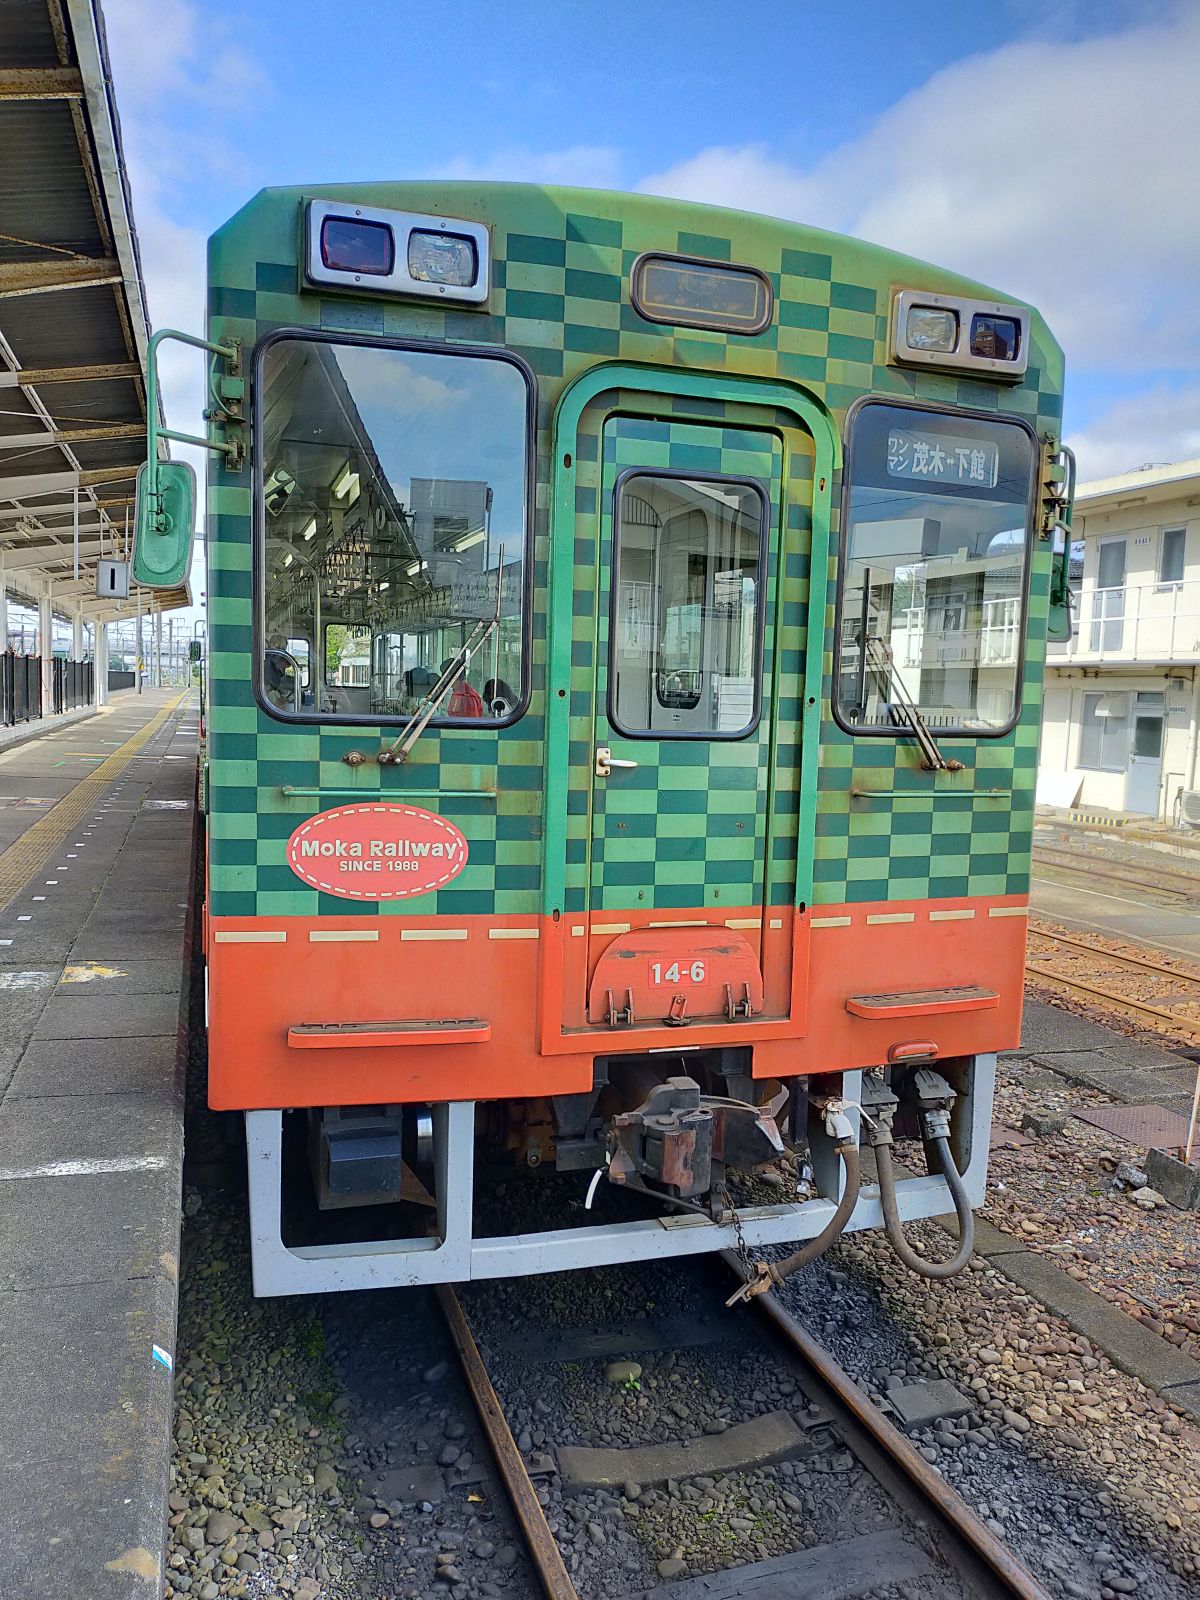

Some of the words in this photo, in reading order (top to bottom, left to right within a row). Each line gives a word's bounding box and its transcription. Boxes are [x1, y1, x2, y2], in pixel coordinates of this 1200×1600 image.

[888, 437, 909, 454] ワン
[887, 455, 909, 471] マン
[911, 441, 946, 476] 茂木
[954, 447, 986, 481] 下館
[301, 839, 362, 857] Moka
[370, 839, 457, 860] Railway
[339, 860, 382, 872] SINCE
[385, 860, 419, 872] 1988
[651, 960, 705, 984] 14-6
